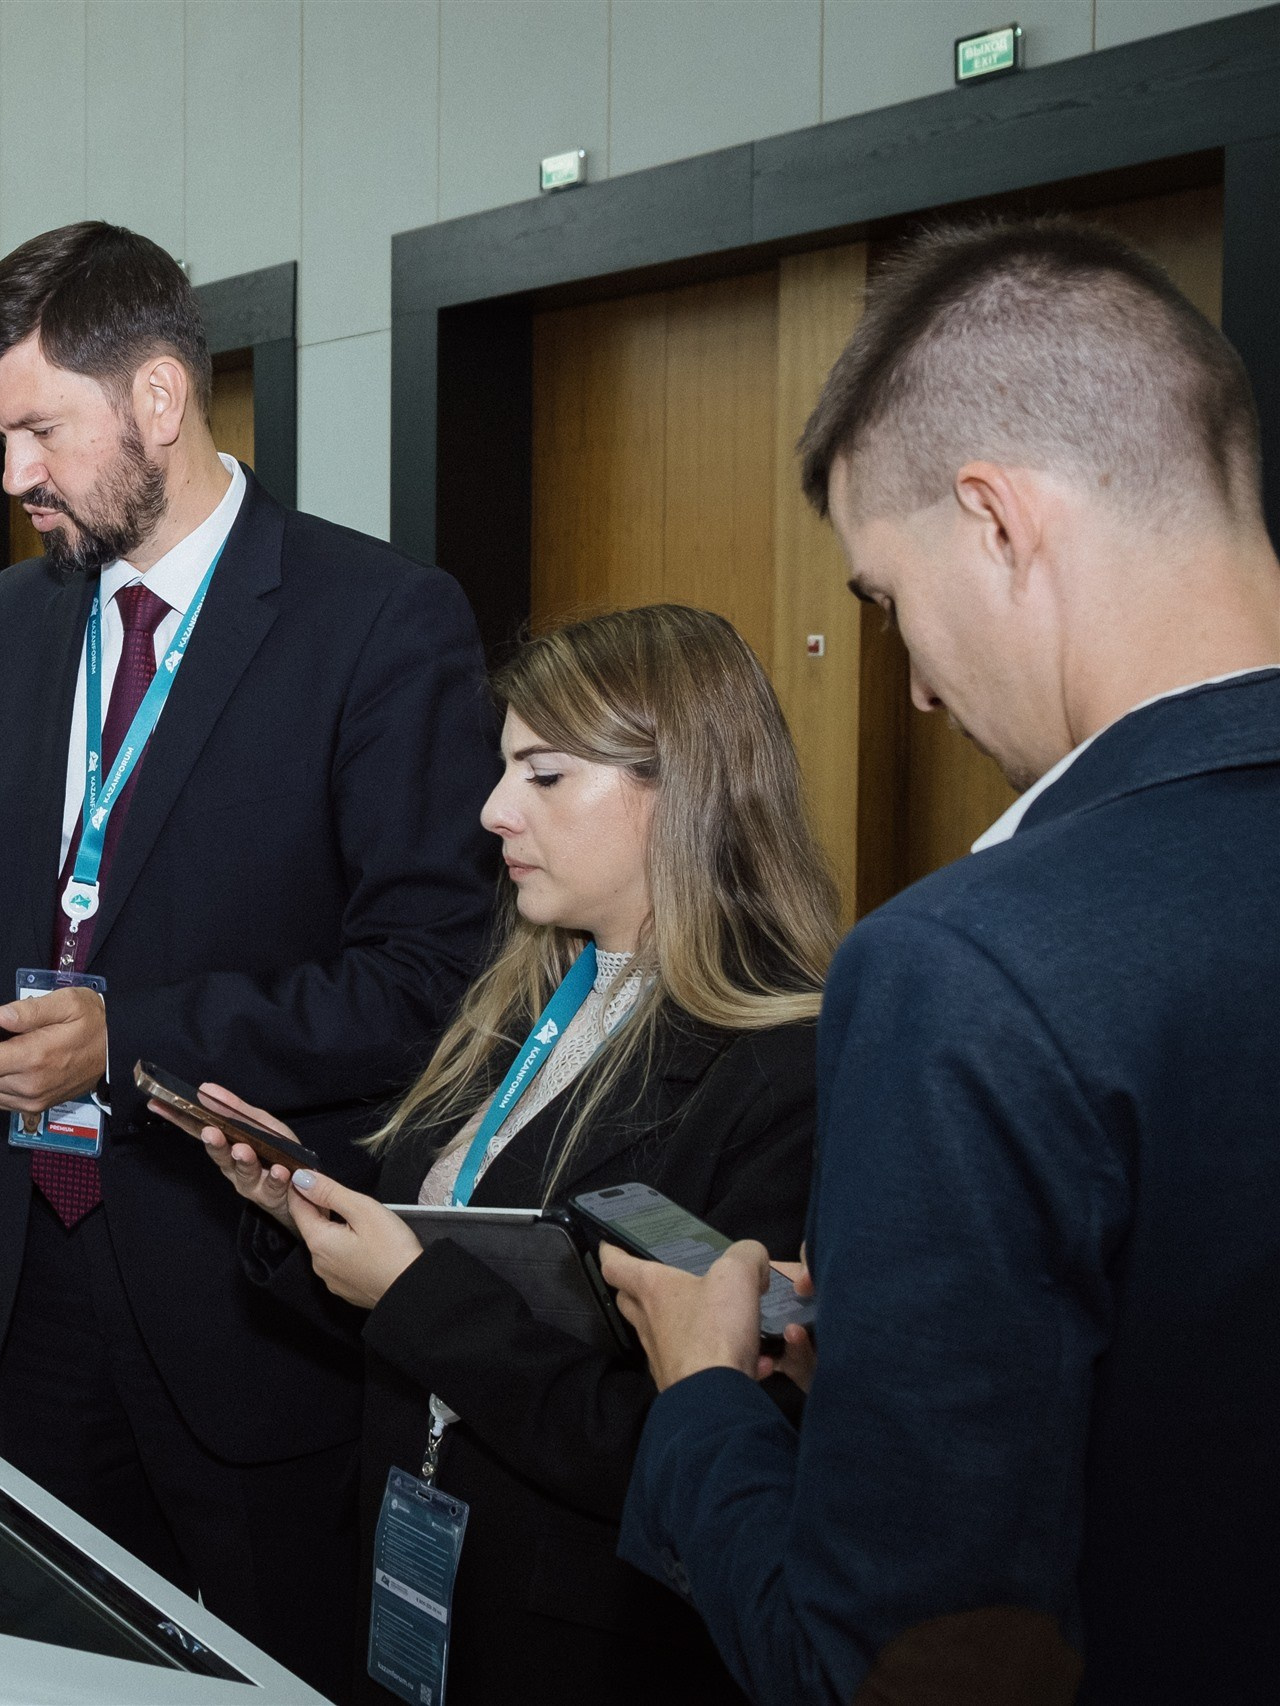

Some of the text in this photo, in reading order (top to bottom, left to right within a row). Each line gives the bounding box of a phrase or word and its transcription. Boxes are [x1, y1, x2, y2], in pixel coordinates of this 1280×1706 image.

[965, 38, 1008, 59] ВЫХОД
[973, 53, 999, 69] EXIT
[103, 746, 135, 803] KAZANFORUM
[499, 1046, 541, 1109] KAZANFORUM
[49, 1124, 74, 1133] PREMIUM
